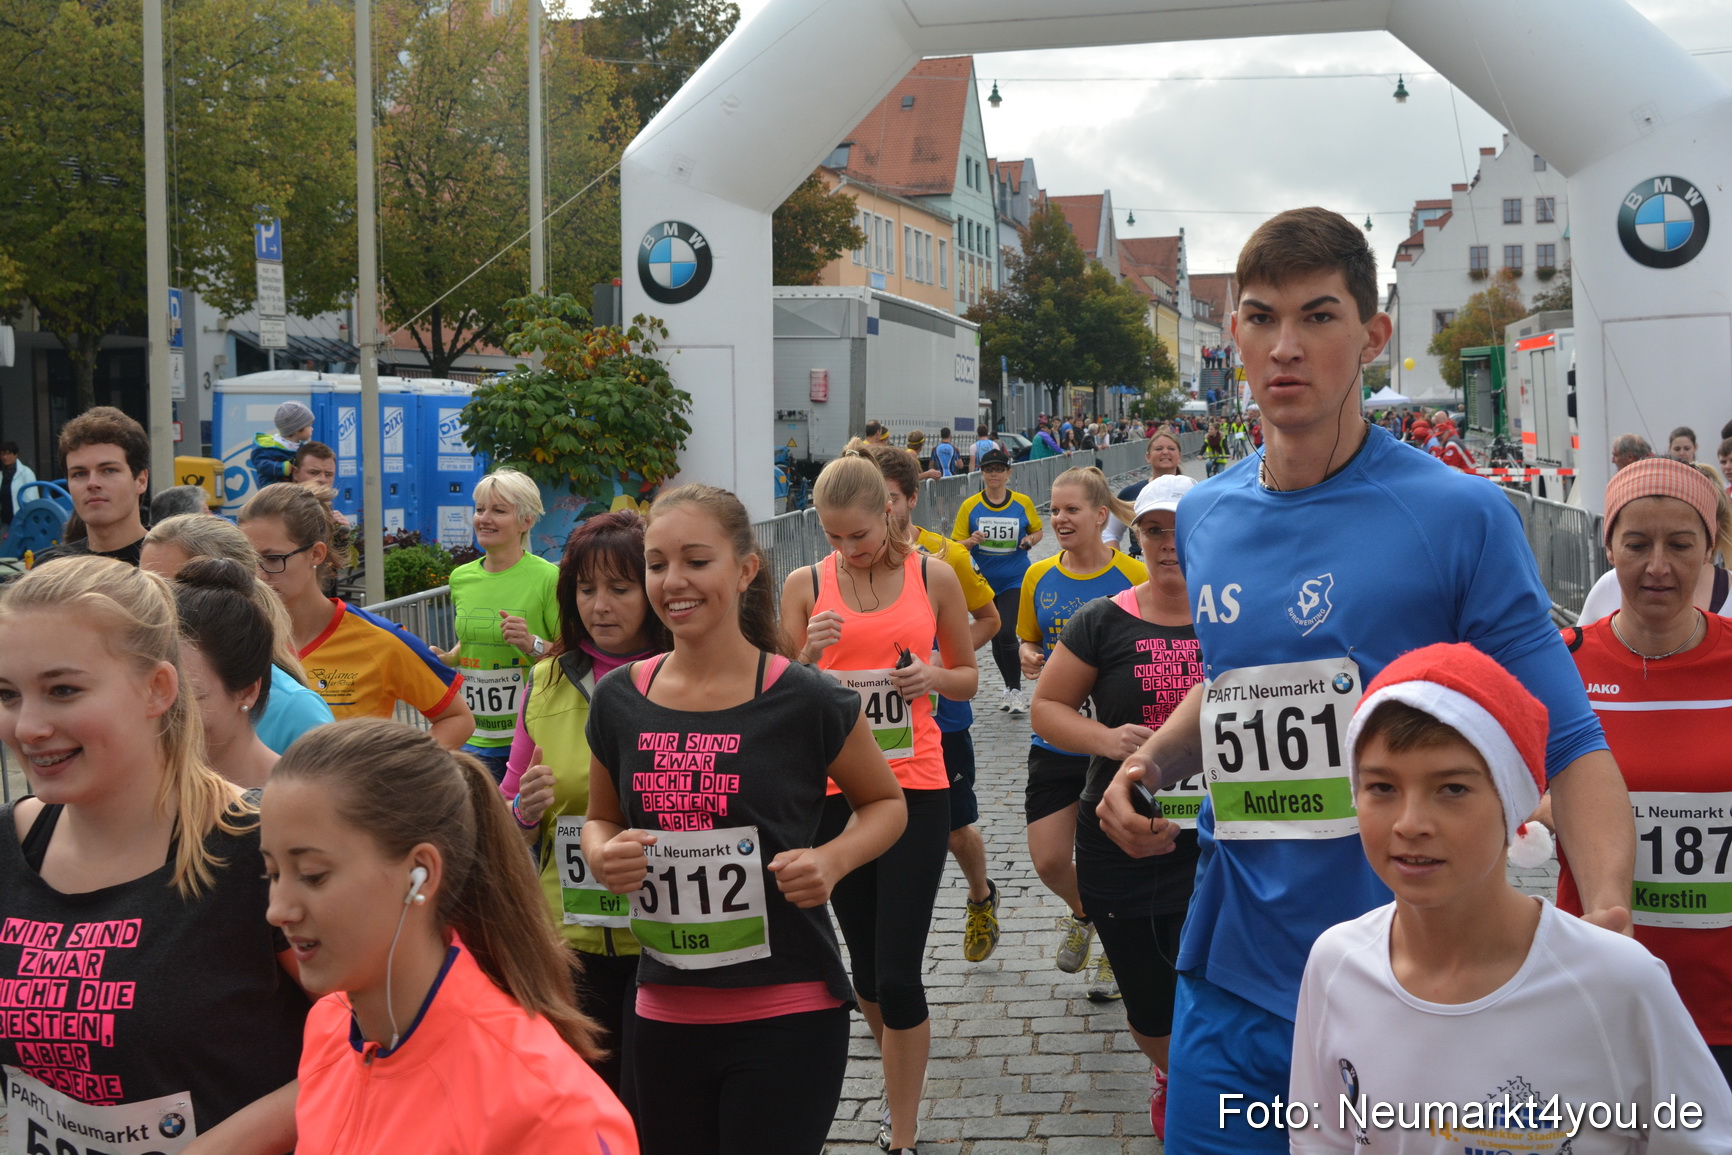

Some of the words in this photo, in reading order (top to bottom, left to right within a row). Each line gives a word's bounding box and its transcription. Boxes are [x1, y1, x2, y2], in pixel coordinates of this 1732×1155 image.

[1624, 177, 1703, 210] BMW
[642, 222, 706, 251] BMW
[203, 371, 211, 390] 3
[983, 525, 1014, 539] 5151
[1196, 583, 1243, 624] AS
[1287, 607, 1327, 627] BURGWEINTING
[1136, 639, 1167, 652] WIR
[1171, 639, 1200, 650] SIN
[1152, 650, 1197, 662] ZWAR
[463, 675, 477, 683] ARTL
[477, 676, 510, 684] Neumarkt
[1134, 663, 1182, 677] NICHT
[1188, 663, 1205, 675] DI
[1142, 676, 1204, 691] BESTEN
[1206, 685, 1248, 704] PARTL
[1249, 679, 1326, 700] Neumarkt
[1586, 683, 1620, 694] JAKO
[466, 685, 517, 712] 5167
[864, 690, 904, 724] 40
[1156, 689, 1187, 704] ABE
[638, 733, 679, 751] WIR
[685, 733, 741, 753] SIND
[1214, 703, 1342, 774] 5161
[654, 751, 716, 772] ZWAR
[633, 772, 692, 791] NICHT
[700, 772, 740, 793] DIE
[642, 792, 728, 816] BESTEN,
[1160, 801, 1201, 815] erena
[1244, 790, 1325, 815] Andreas
[1649, 806, 1724, 819] Neumarkt
[557, 826, 583, 837] PART
[658, 811, 713, 832] ABER
[643, 845, 661, 857] RTL
[664, 844, 731, 858] Neumarkt
[1640, 826, 1732, 875] 187
[639, 863, 750, 916] 5112
[1635, 887, 1707, 909] Kerstin
[600, 896, 621, 912] Evi
[0, 917, 65, 949] WIR
[65, 918, 142, 948] SIND
[670, 930, 710, 950] Lisa
[17, 947, 106, 978] ZWAR
[0, 979, 69, 1008] ICHT
[77, 980, 136, 1010] DIE
[16, 1042, 91, 1072] ABER
[30, 1067, 124, 1101] SSERE
[11, 1082, 55, 1123] PARTL
[56, 1110, 150, 1144] Neumarkt
